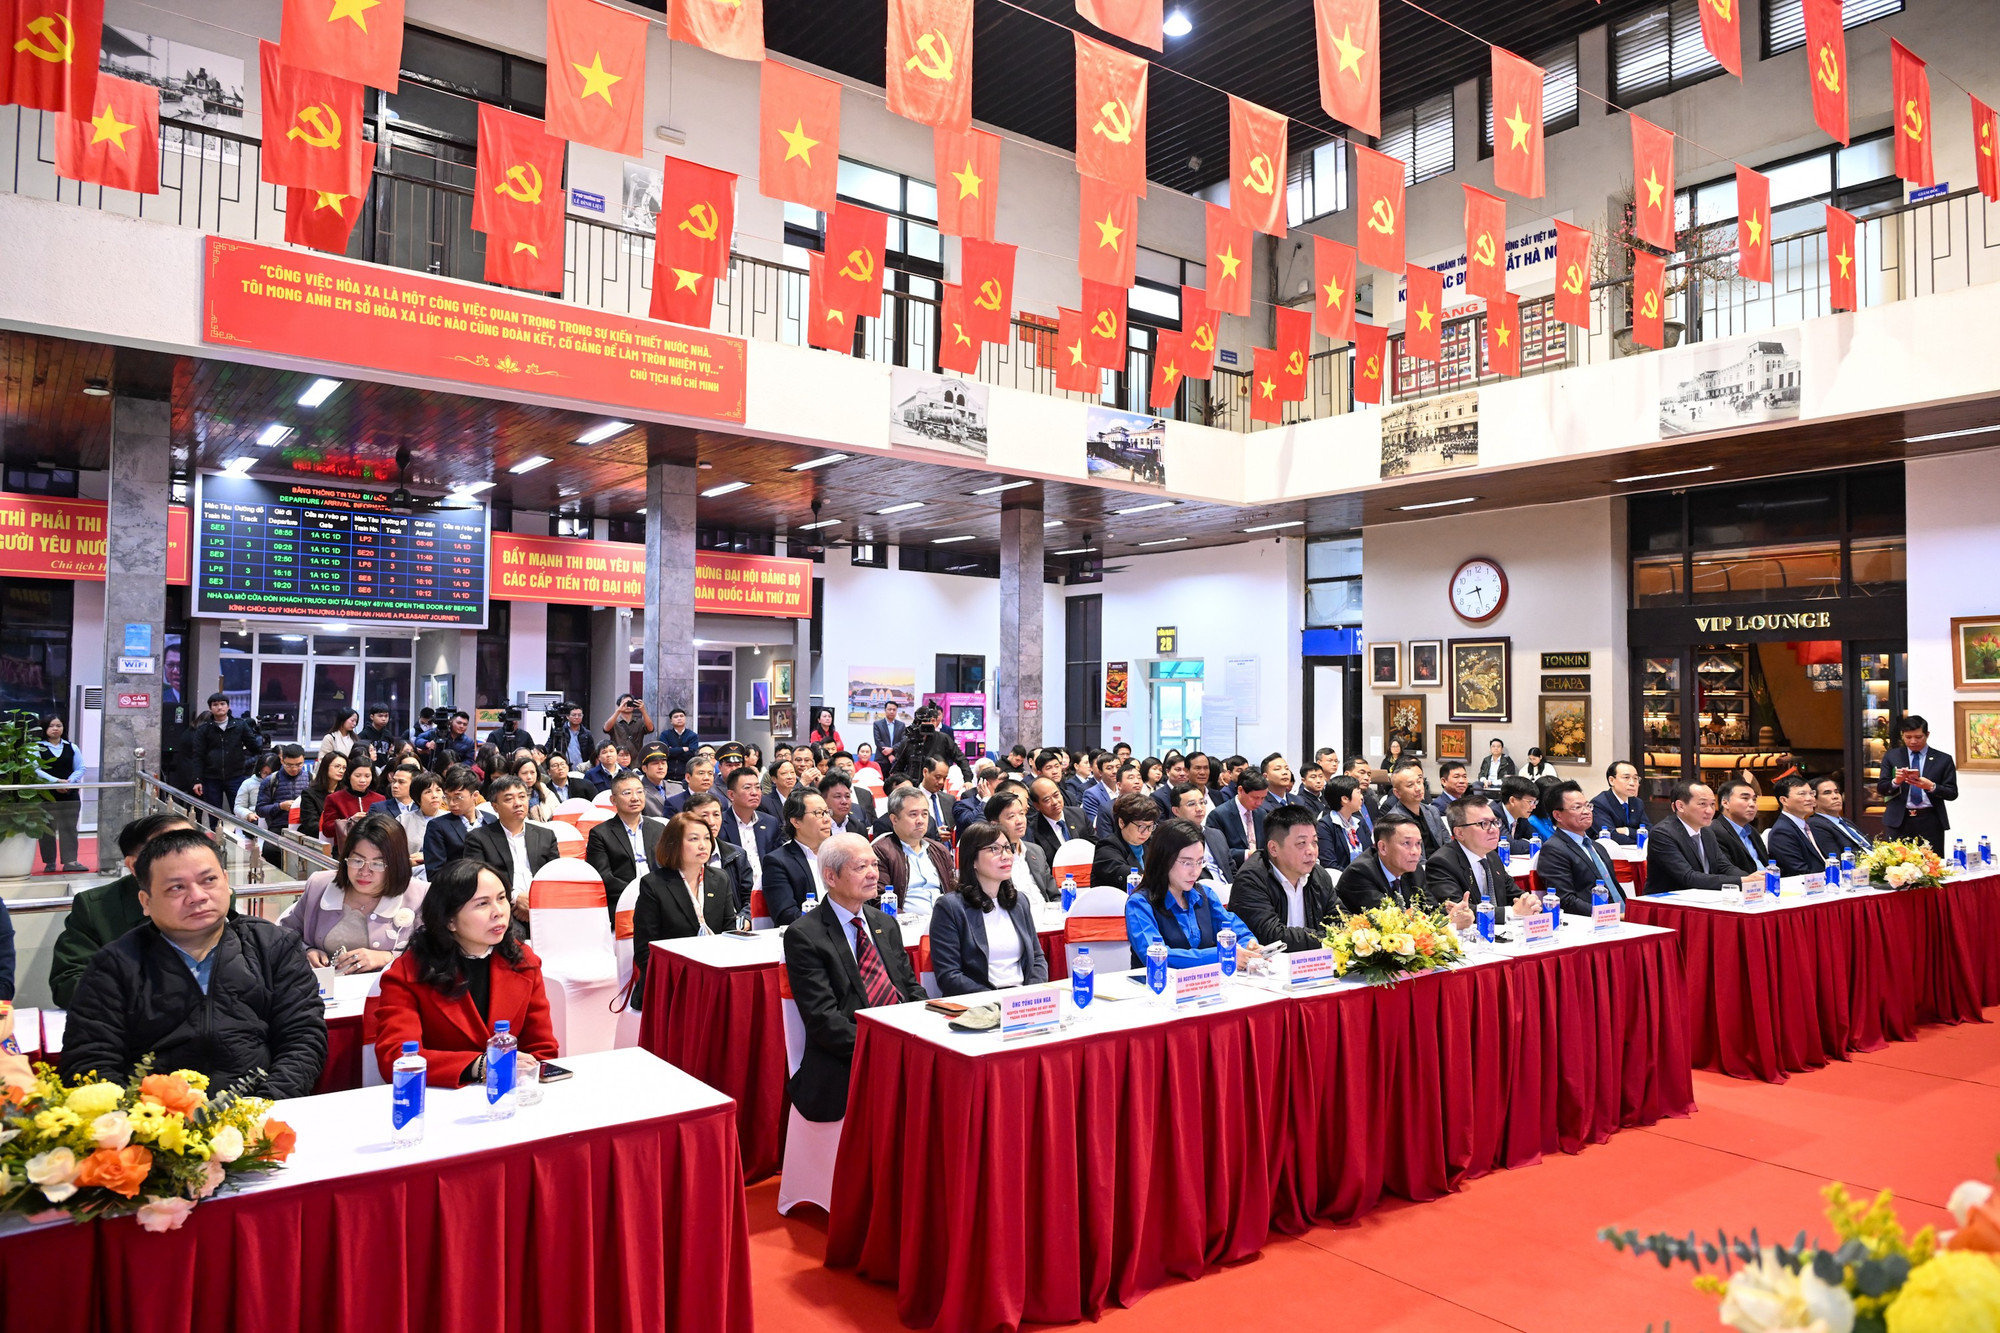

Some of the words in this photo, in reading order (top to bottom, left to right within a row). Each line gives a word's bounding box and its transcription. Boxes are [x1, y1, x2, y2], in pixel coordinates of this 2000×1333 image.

[1437, 259, 1456, 272] NHÁNH
[1521, 234, 1532, 247] SẮT
[1533, 230, 1546, 244] VIỆT
[1548, 228, 1557, 239] NA
[1506, 252, 1521, 271] ẮT
[1524, 247, 1541, 266] HÀ
[260, 264, 301, 283] “CÔNG
[305, 272, 333, 291] VIỆC
[336, 276, 360, 294] HỎA
[364, 285, 380, 298] XA
[384, 286, 399, 302] LÀ
[402, 291, 426, 308] MỘT
[429, 295, 460, 313] CÔNG
[463, 302, 487, 319] VIỆC
[490, 308, 518, 323] QUAN
[522, 313, 556, 331] TRỌNG
[559, 320, 592, 337] TRONG
[594, 328, 607, 342] SỰ
[610, 329, 632, 345] KIẾN
[634, 334, 662, 350] THIẾT
[664, 338, 689, 354] NƯỚC
[691, 342, 712, 358] NHÀ.
[241, 279, 263, 296] TÔI
[266, 285, 302, 302] MONG
[306, 292, 332, 307] ANH
[335, 297, 352, 311] EM
[355, 299, 370, 314] SỞ
[374, 301, 397, 319] HỎA
[400, 309, 416, 323] XA
[420, 311, 441, 327] LÚC
[444, 316, 468, 332] NÀO
[470, 320, 499, 337] CŨNG
[502, 327, 530, 342] ĐOÀN
[533, 331, 556, 348] KẾT,
[559, 336, 573, 350] CỐ
[575, 338, 601, 355] GẮNG
[604, 343, 616, 358] ĐỂ
[619, 346, 639, 362] LÀM
[642, 352, 666, 366] TRÒN
[669, 356, 696, 372] NHIỆM
[630, 368, 647, 381] CHỦ
[649, 372, 668, 384] TỊCH
[671, 372, 682, 386] HỒ
[684, 376, 697, 389] CHÍ
[699, 380, 719, 392] MINH
[280, 495, 320, 505] DEPARTURE
[0, 508, 25, 527] THÌ
[31, 509, 70, 530] PHẢI
[76, 516, 101, 532] THI
[40, 535, 71, 554] YÊU
[76, 539, 107, 557] NƯỚ
[51, 559, 73, 570] Chủ
[76, 561, 95, 572] tịch
[98, 563, 107, 571] H
[503, 546, 526, 565] ĐẨY
[529, 552, 562, 570] MẠNH
[566, 555, 582, 570] THI
[586, 557, 607, 572] ĐUA
[609, 557, 629, 573] YÊU
[725, 568, 740, 583] ĐẠI
[743, 568, 758, 585] HỘI
[761, 569, 786, 585] ĐẢNG
[789, 572, 800, 588] BỘ
[503, 571, 526, 587] CÁC
[530, 571, 552, 588] CẤP
[556, 573, 580, 590] TIẾN
[583, 576, 600, 591] TỚI
[603, 580, 620, 595] ĐẠI
[624, 579, 641, 597] HỘI
[695, 585, 715, 599] OÀN
[718, 585, 743, 602] QUỐC
[746, 587, 763, 603] LẦN
[766, 590, 784, 604] THỨ
[785, 593, 800, 605] XIV
[1695, 617, 1732, 632] VIP
[1736, 612, 1830, 631] LOUNGE
[1160, 637, 1172, 651] 2B
[1544, 655, 1587, 666] TONKIN
[1545, 677, 1585, 689] CHAPA
